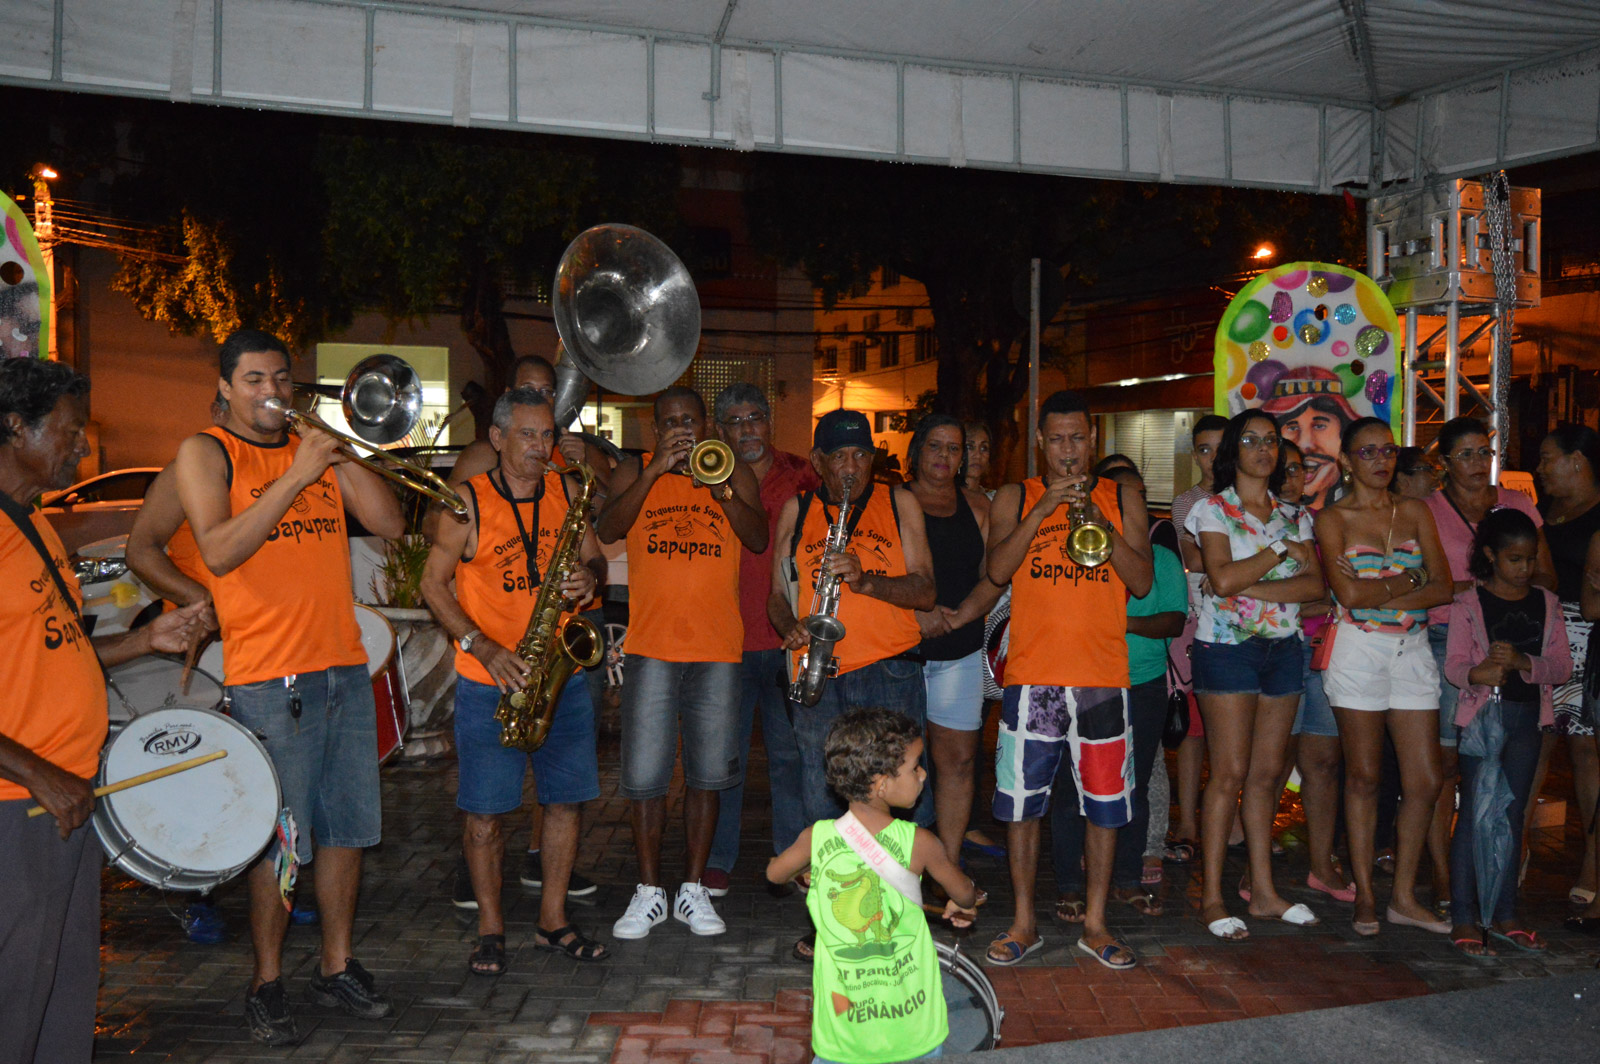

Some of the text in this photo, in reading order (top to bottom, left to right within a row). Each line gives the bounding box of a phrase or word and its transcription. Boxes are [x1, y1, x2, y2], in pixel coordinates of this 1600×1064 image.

[315, 479, 336, 493] opr
[646, 505, 688, 519] Orquestra
[691, 504, 701, 513] de
[540, 527, 551, 537] de
[853, 528, 893, 548] de Sopro
[1035, 523, 1070, 538] rquestr
[647, 533, 722, 561] Sapupara
[1030, 557, 1109, 587] Sapupara
[154, 733, 190, 753] RMV
[847, 989, 926, 1024] VENÂNCIO
